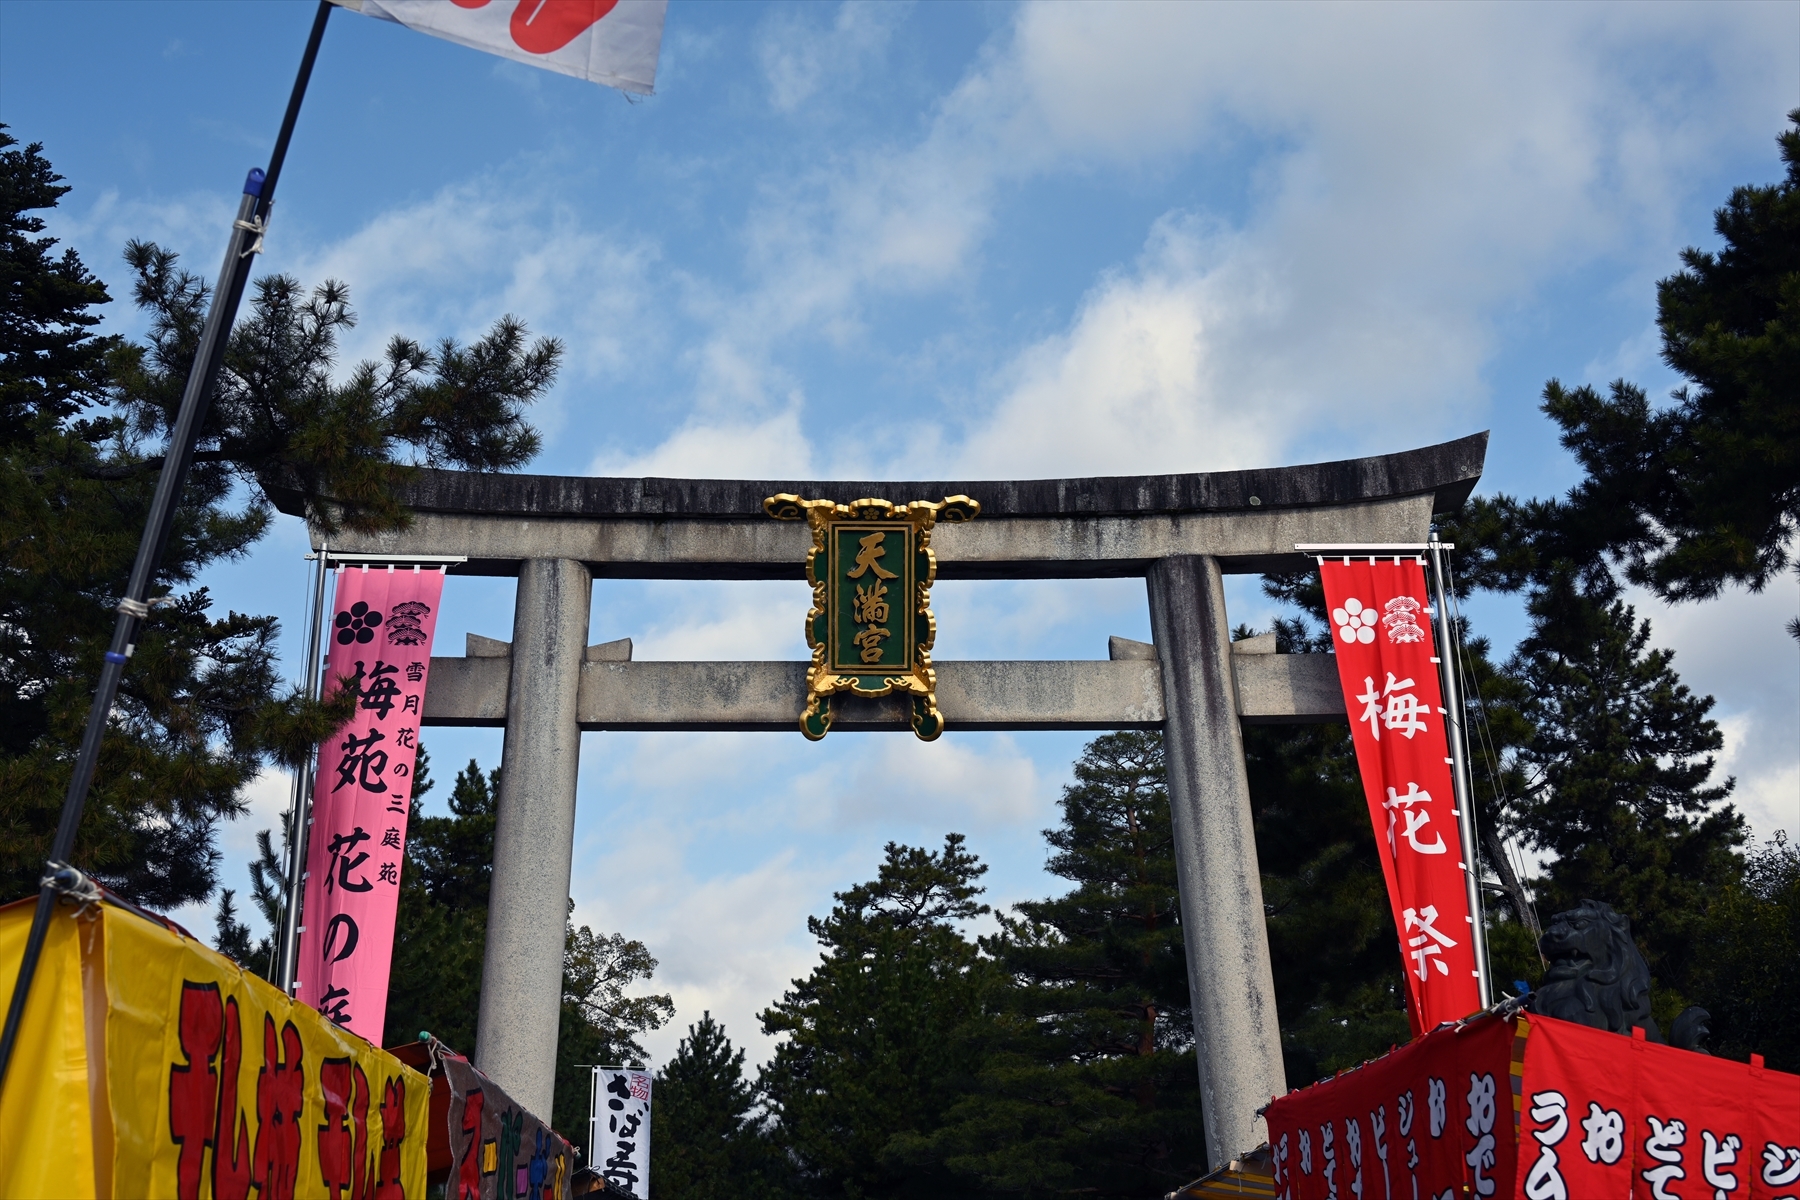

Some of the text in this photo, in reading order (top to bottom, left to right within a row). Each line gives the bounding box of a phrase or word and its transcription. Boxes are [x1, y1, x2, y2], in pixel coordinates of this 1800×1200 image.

[847, 531, 900, 664] 天満宮
[376, 661, 426, 886] 雪月花の三庭苑
[1356, 671, 1458, 983] 梅花祭
[629, 1074, 651, 1101] 名物
[1320, 1121, 1338, 1200] どて
[1465, 1072, 1496, 1200] おで
[1580, 1101, 1625, 1164] お
[1701, 1130, 1742, 1200] ビ
[1761, 1141, 1800, 1200] ジ
